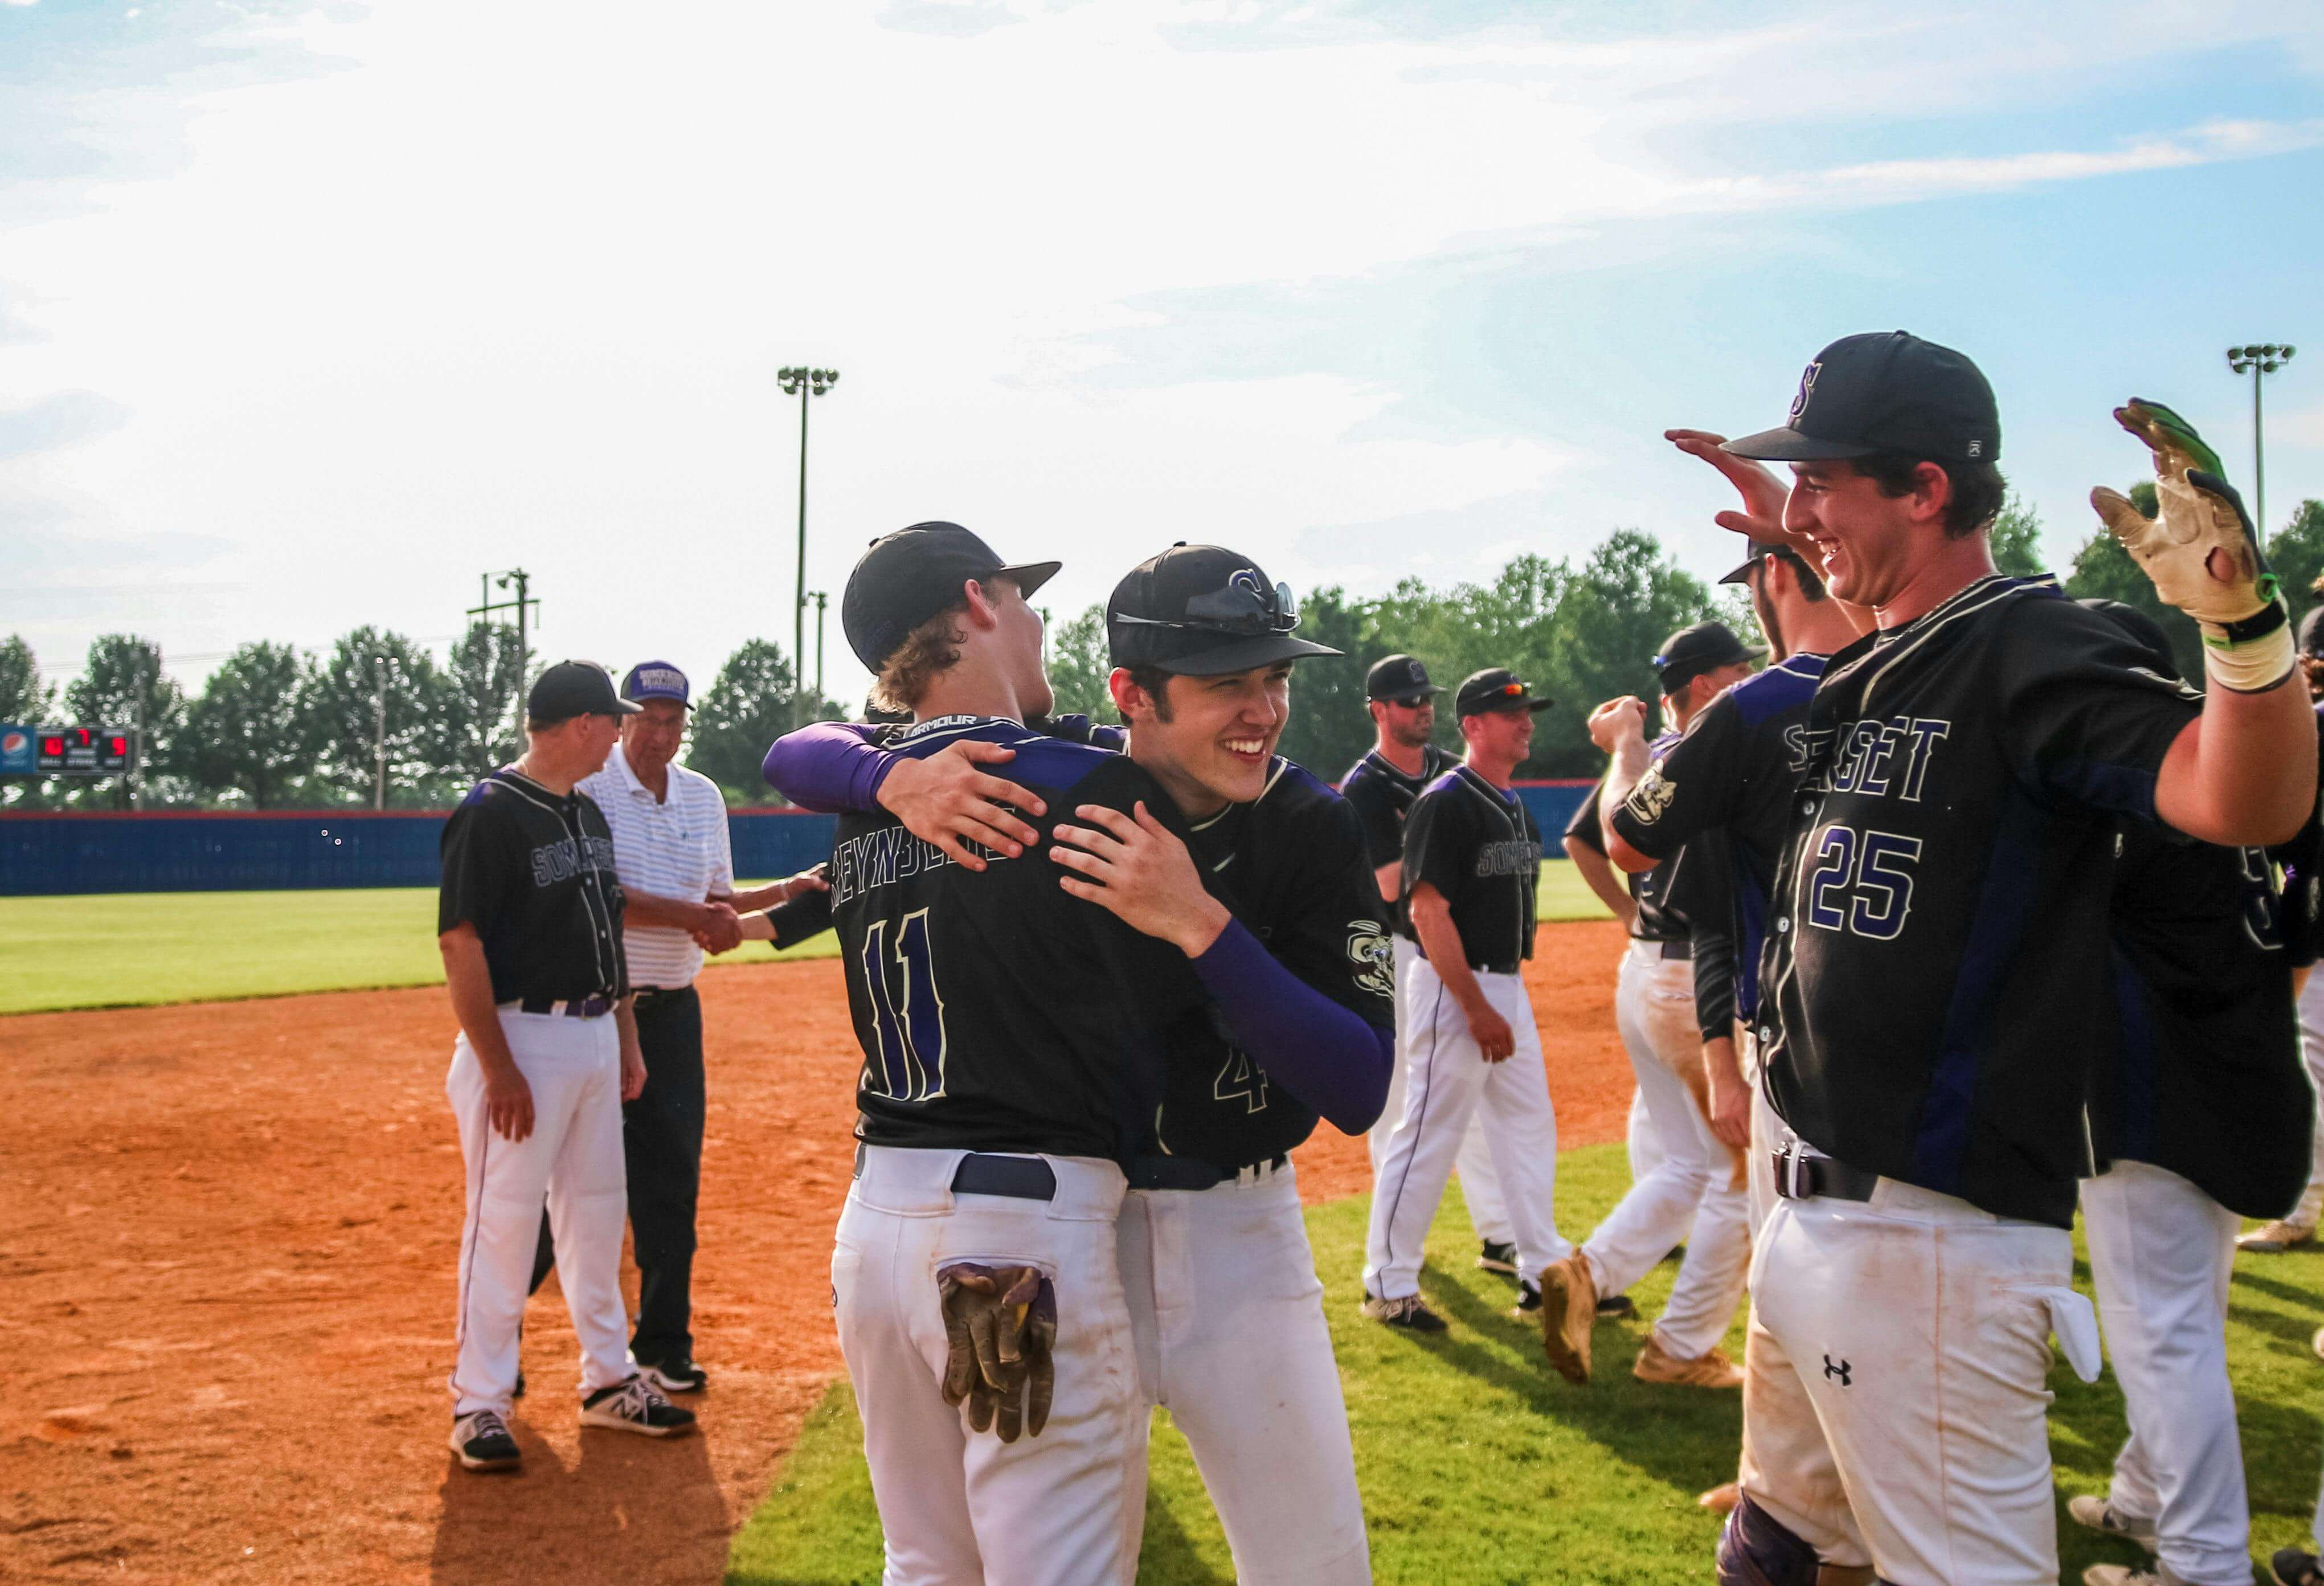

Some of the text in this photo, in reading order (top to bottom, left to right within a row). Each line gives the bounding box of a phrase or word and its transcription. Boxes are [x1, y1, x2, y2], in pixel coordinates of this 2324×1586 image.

[910, 715, 977, 737] ARMOUR
[1809, 825, 1923, 941] 25
[862, 906, 947, 1102] 11
